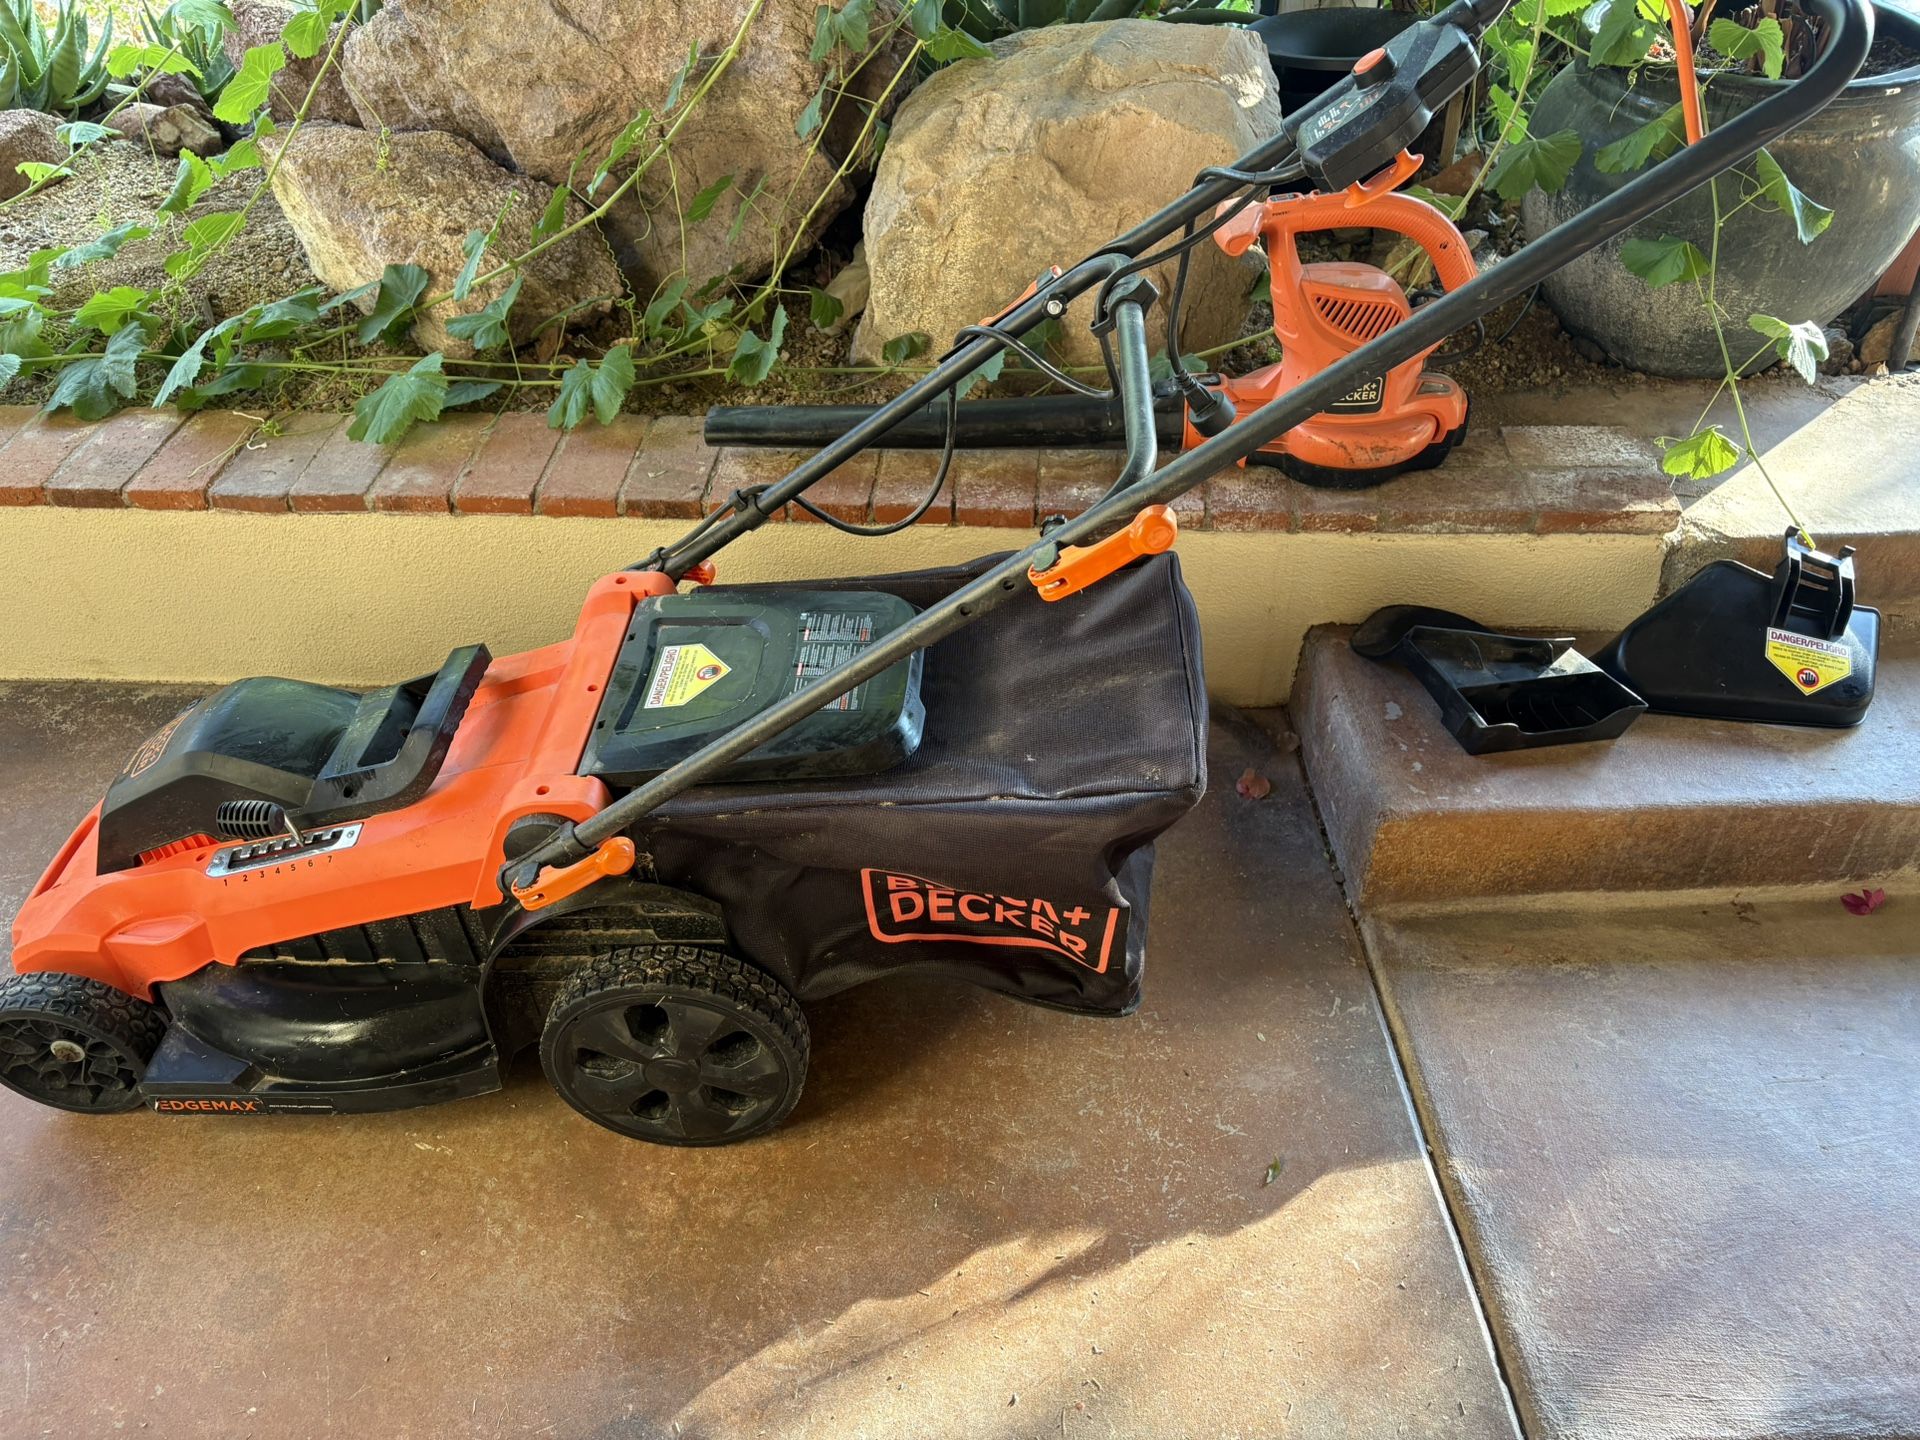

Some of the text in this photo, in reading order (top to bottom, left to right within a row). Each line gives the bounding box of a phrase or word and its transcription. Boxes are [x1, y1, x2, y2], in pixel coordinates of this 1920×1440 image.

[1340, 391, 1377, 401] CKER
[1770, 631, 1847, 656] DANGER/PELIGRO
[650, 648, 678, 705] DANGER/PELIGRO
[242, 874, 248, 882] 2
[260, 870, 265, 878] 3
[290, 864, 296, 872] 5
[327, 855, 333, 863] 7
[889, 889, 1088, 960] DECKER
[159, 1100, 258, 1112] EDGEMAX
